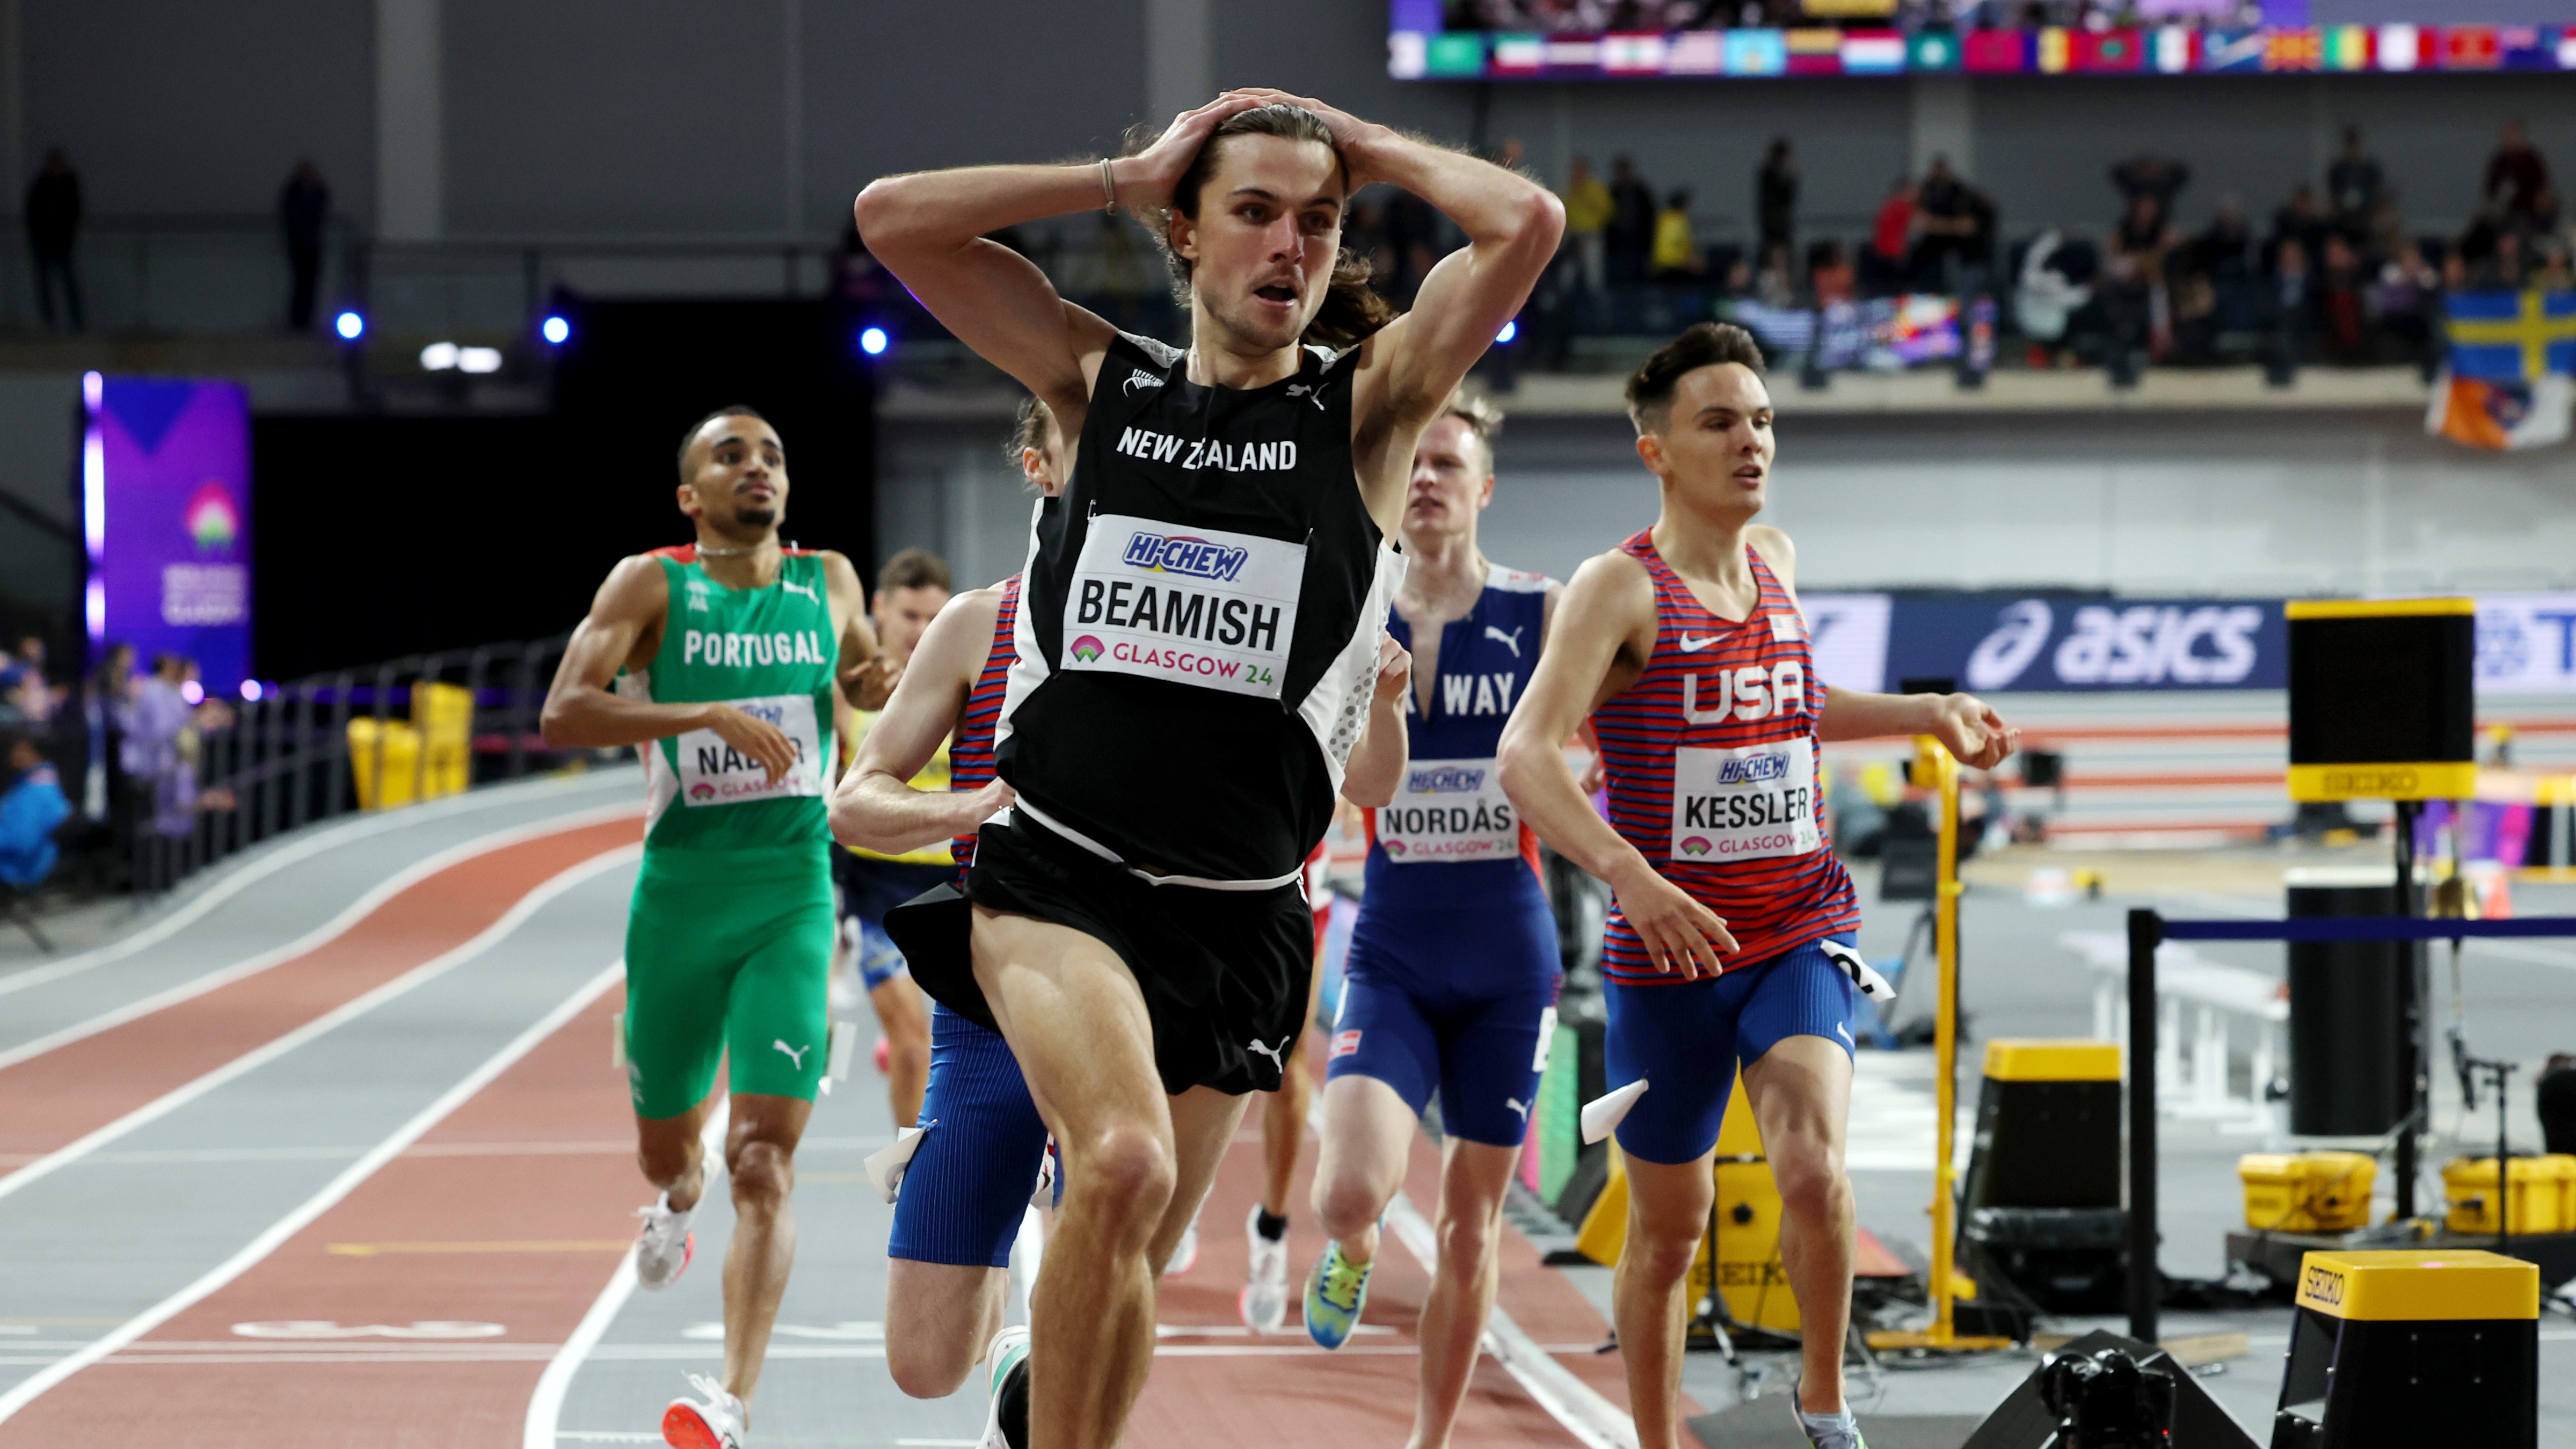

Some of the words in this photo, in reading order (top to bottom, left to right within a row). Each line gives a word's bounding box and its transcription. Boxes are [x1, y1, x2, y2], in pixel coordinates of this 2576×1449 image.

[1117, 427, 1184, 463] NEW
[1122, 531, 1248, 582] HI-CHEW
[1078, 579, 1280, 651] BEAMISH
[684, 630, 826, 667] PORTUGAL
[1113, 642, 1241, 679] GLASGOW
[1245, 664, 1273, 686] 24
[1684, 660, 1807, 724] USA
[1718, 752, 1791, 785] HI-CHEW
[1386, 799, 1511, 834] NORDÅS
[1685, 787, 1807, 828] KESSLER
[1413, 840, 1494, 855] GLASGOW
[1720, 834, 1798, 854] GLASGOW
[1694, 1262, 1784, 1286] SEIK
[2306, 1265, 2345, 1306] SEIKO
